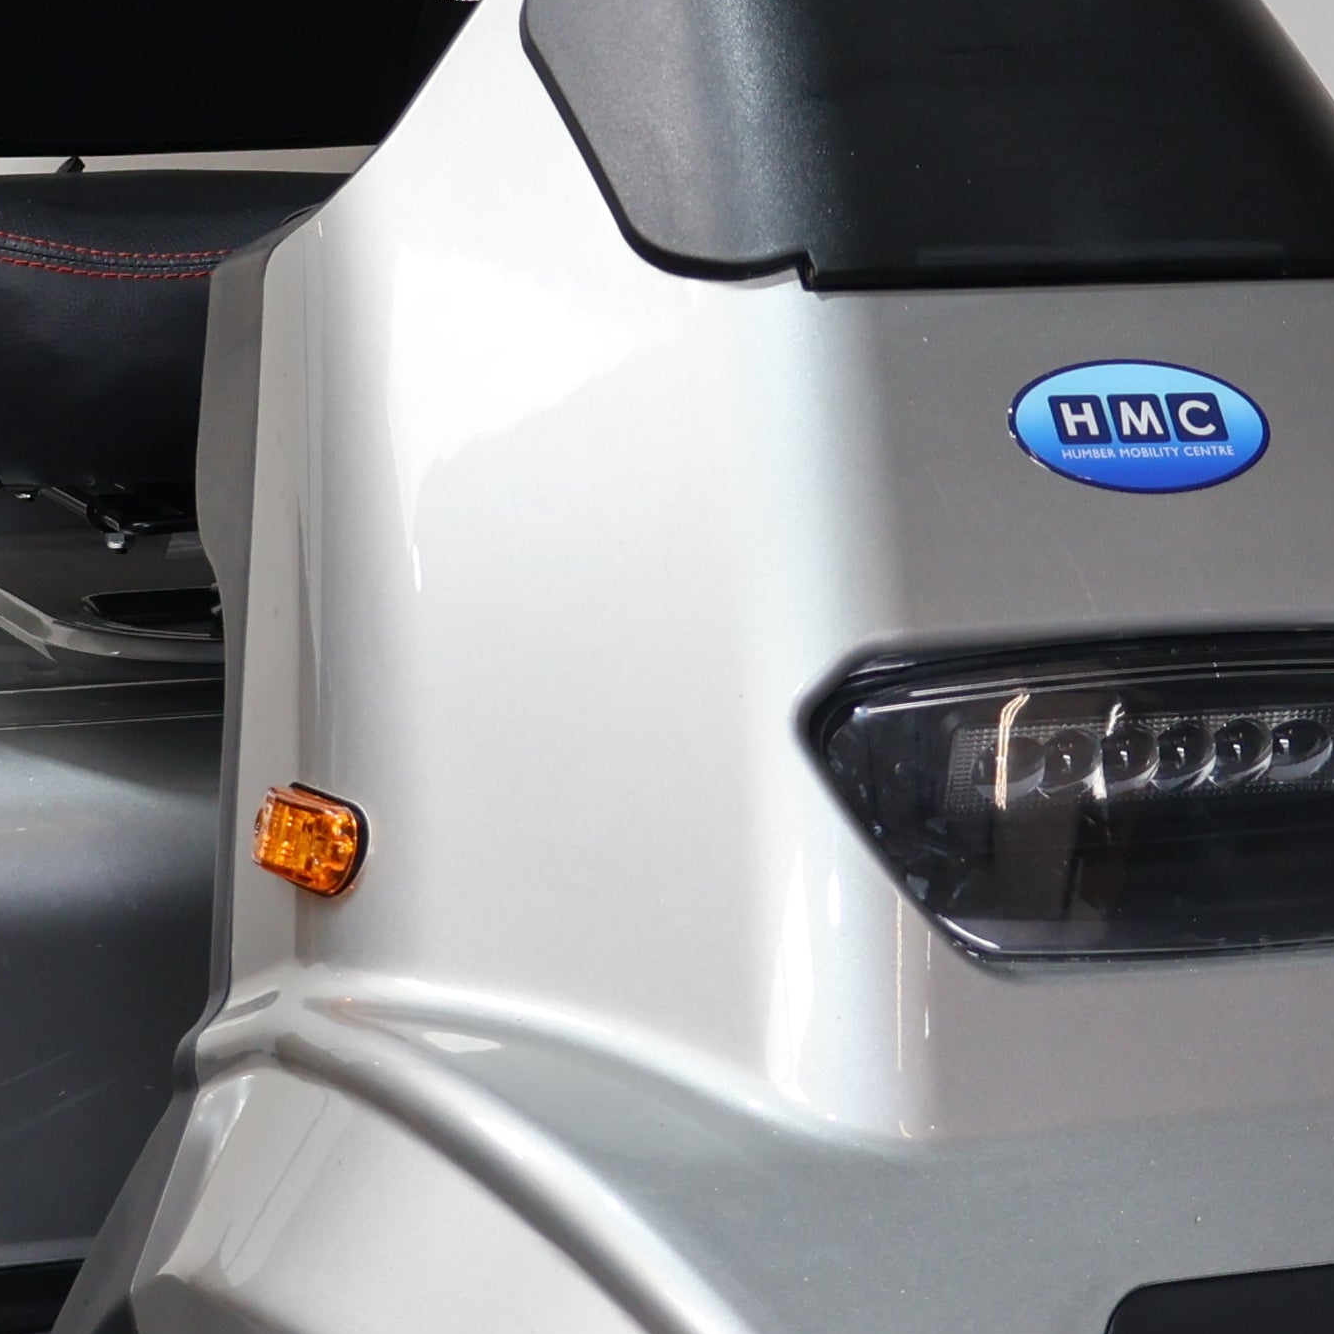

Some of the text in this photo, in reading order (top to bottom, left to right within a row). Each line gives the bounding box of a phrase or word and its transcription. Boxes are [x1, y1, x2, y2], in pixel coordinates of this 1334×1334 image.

[1059, 400, 1217, 436] HMC
[1062, 445, 1235, 460] HUMBER MOBILITY CENTRE
